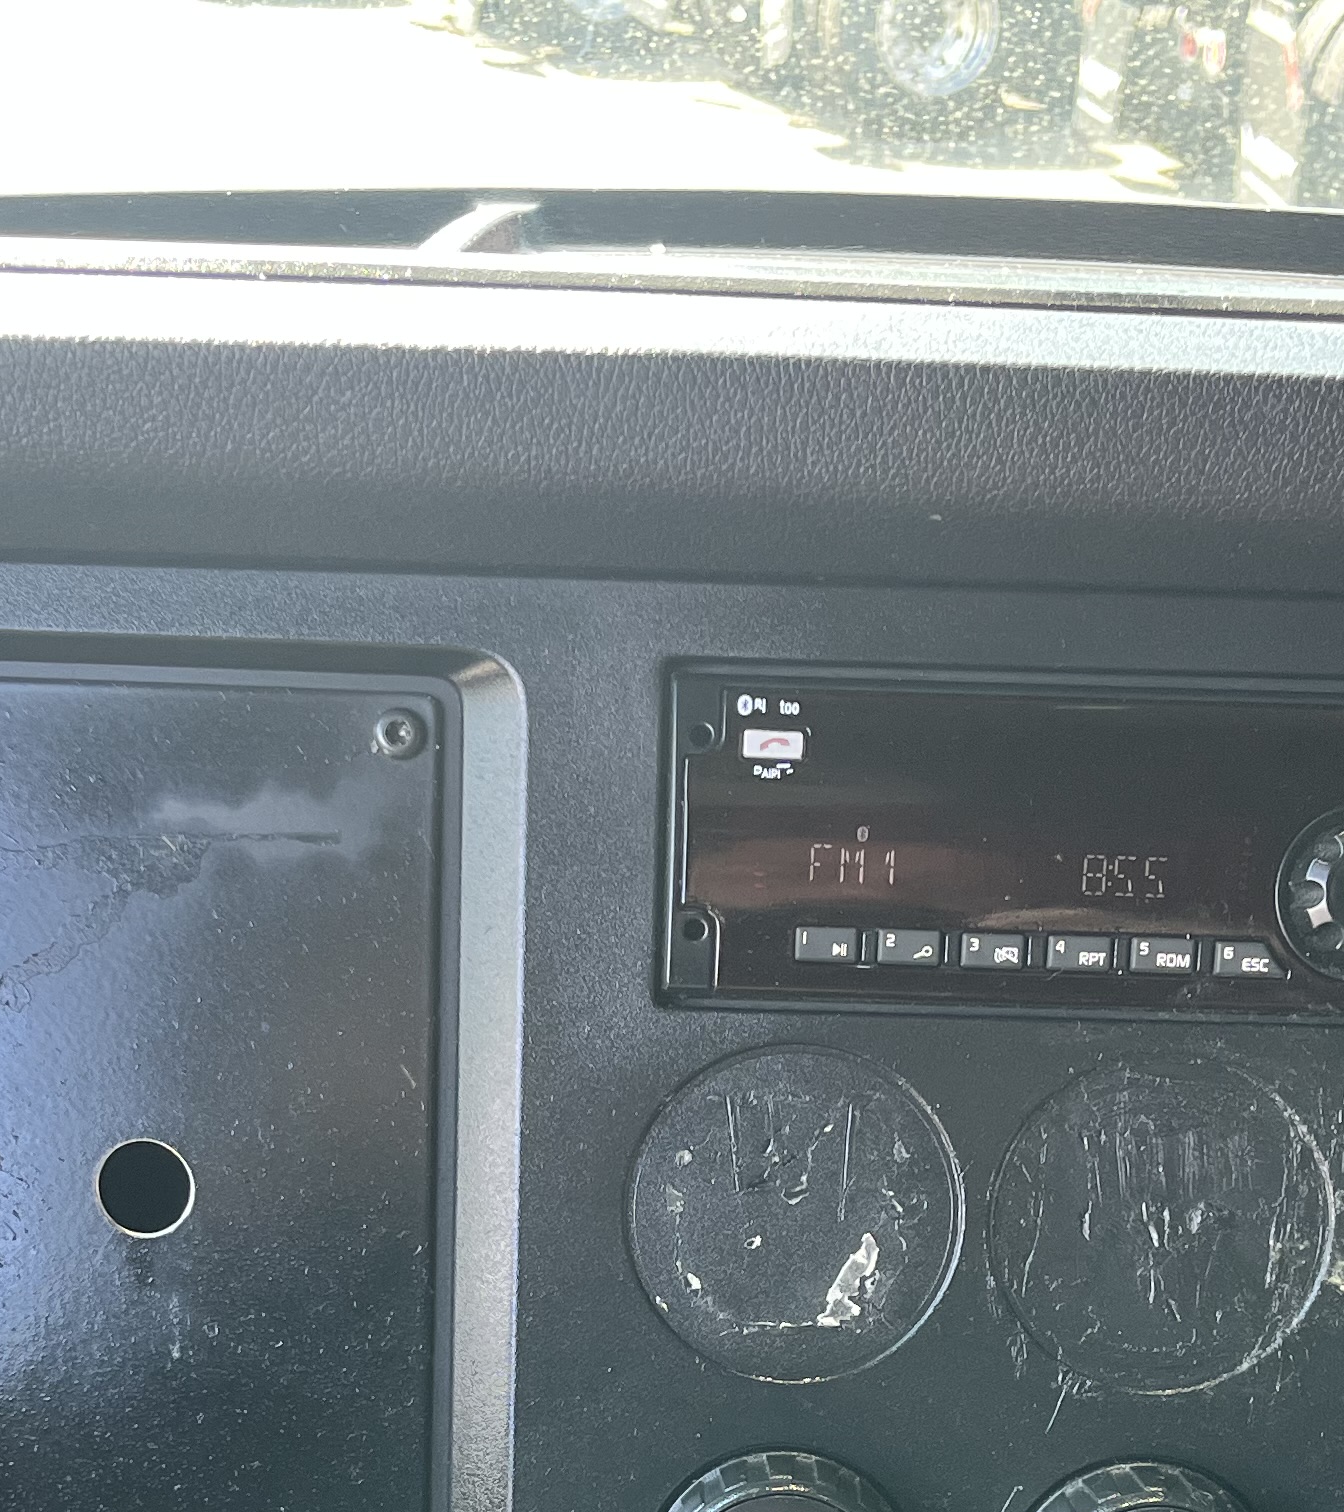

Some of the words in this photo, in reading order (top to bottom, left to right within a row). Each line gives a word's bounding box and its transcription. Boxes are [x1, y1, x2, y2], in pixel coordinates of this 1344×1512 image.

[1082, 854, 1168, 898] 8:55
[801, 930, 808, 946] 1
[886, 934, 896, 948] 2
[969, 938, 980, 952] 3
[1055, 940, 1066, 954] 4
[1139, 942, 1150, 956] 5
[1223, 946, 1234, 960] 6
[1078, 952, 1107, 967] RPT
[1156, 953, 1191, 969] RDM
[1241, 957, 1270, 973] ESC
